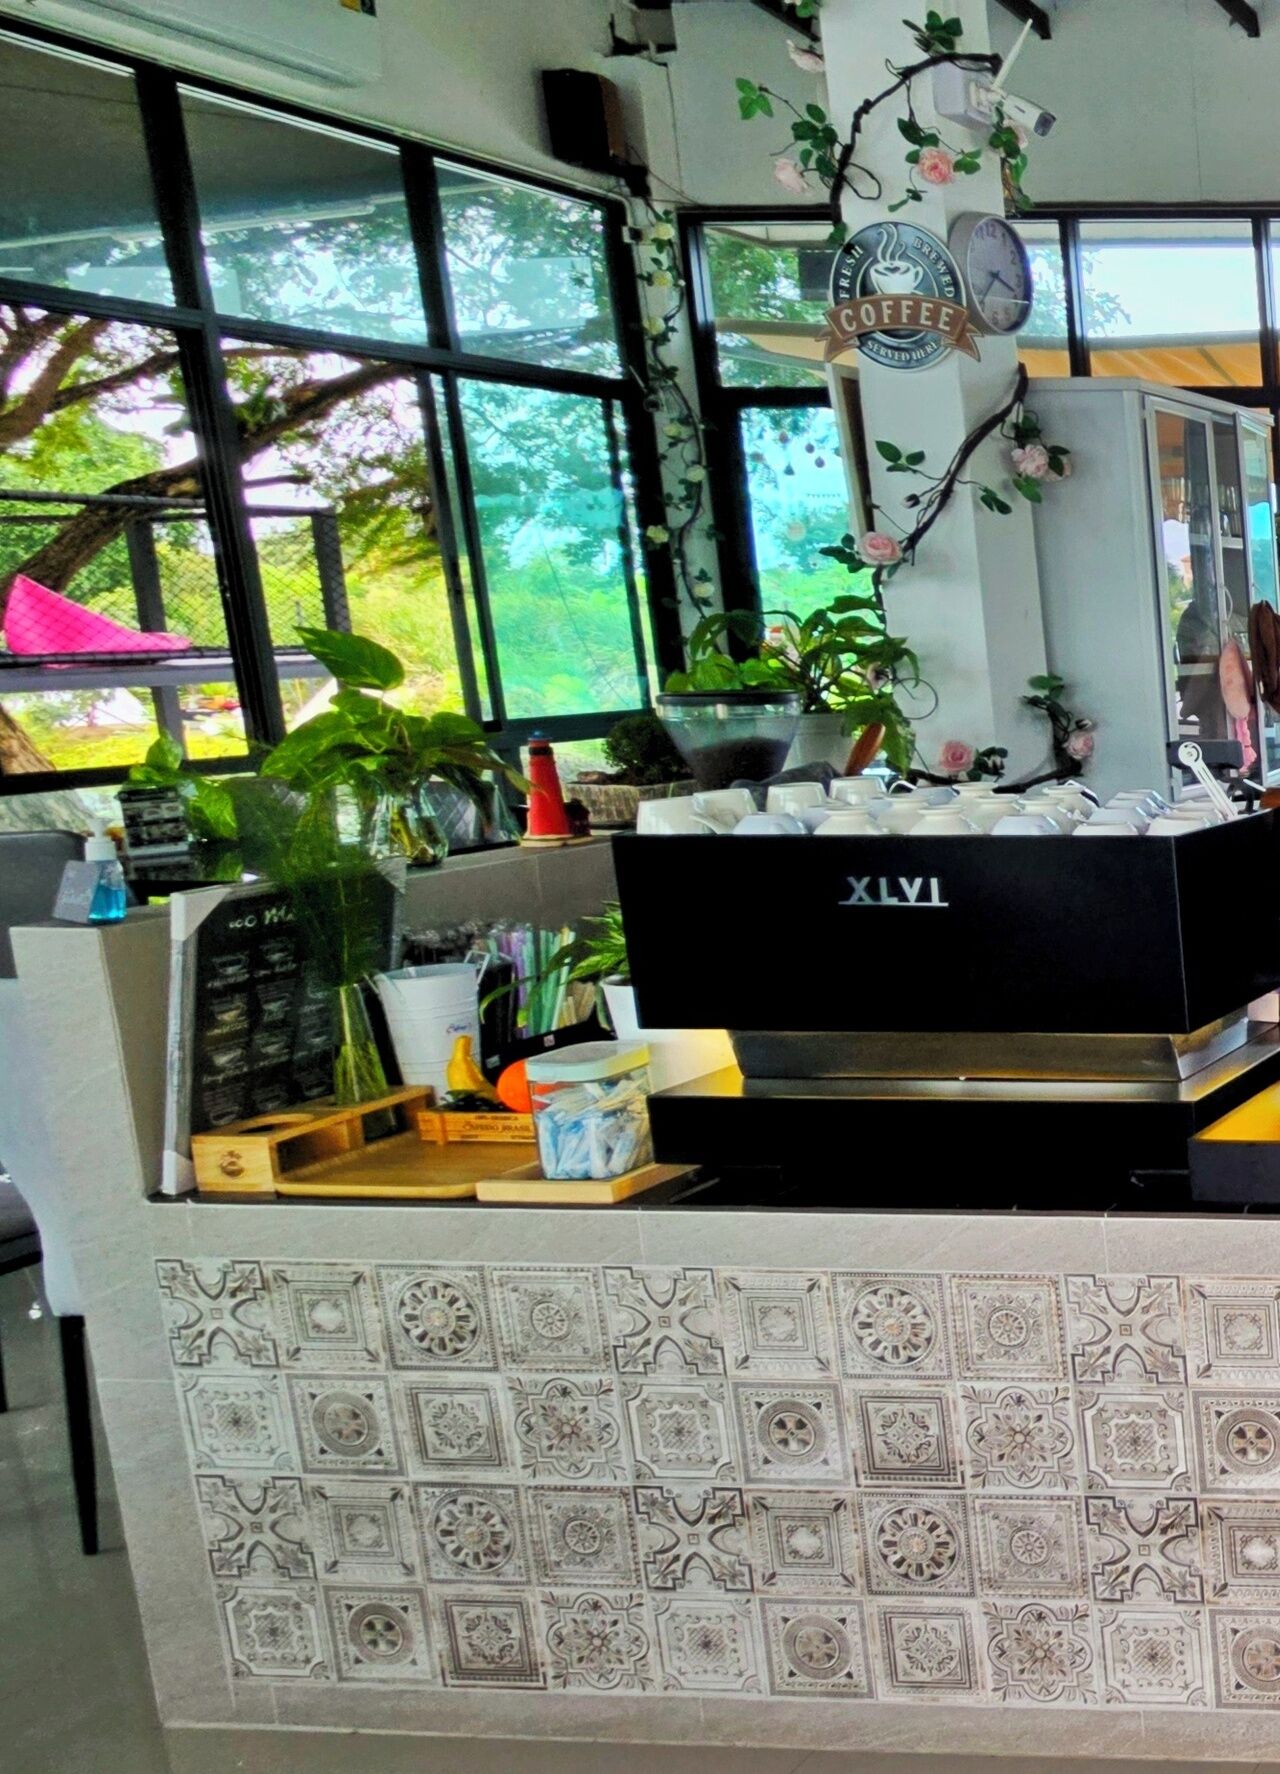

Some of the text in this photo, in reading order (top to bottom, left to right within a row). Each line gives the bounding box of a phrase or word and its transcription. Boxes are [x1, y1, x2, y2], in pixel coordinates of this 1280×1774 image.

[839, 245, 865, 299] FRESH
[913, 236, 955, 298] BREWED
[839, 300, 955, 332] COFFEE
[867, 340, 938, 361] SERVED HERE
[846, 875, 941, 905] XLVI
